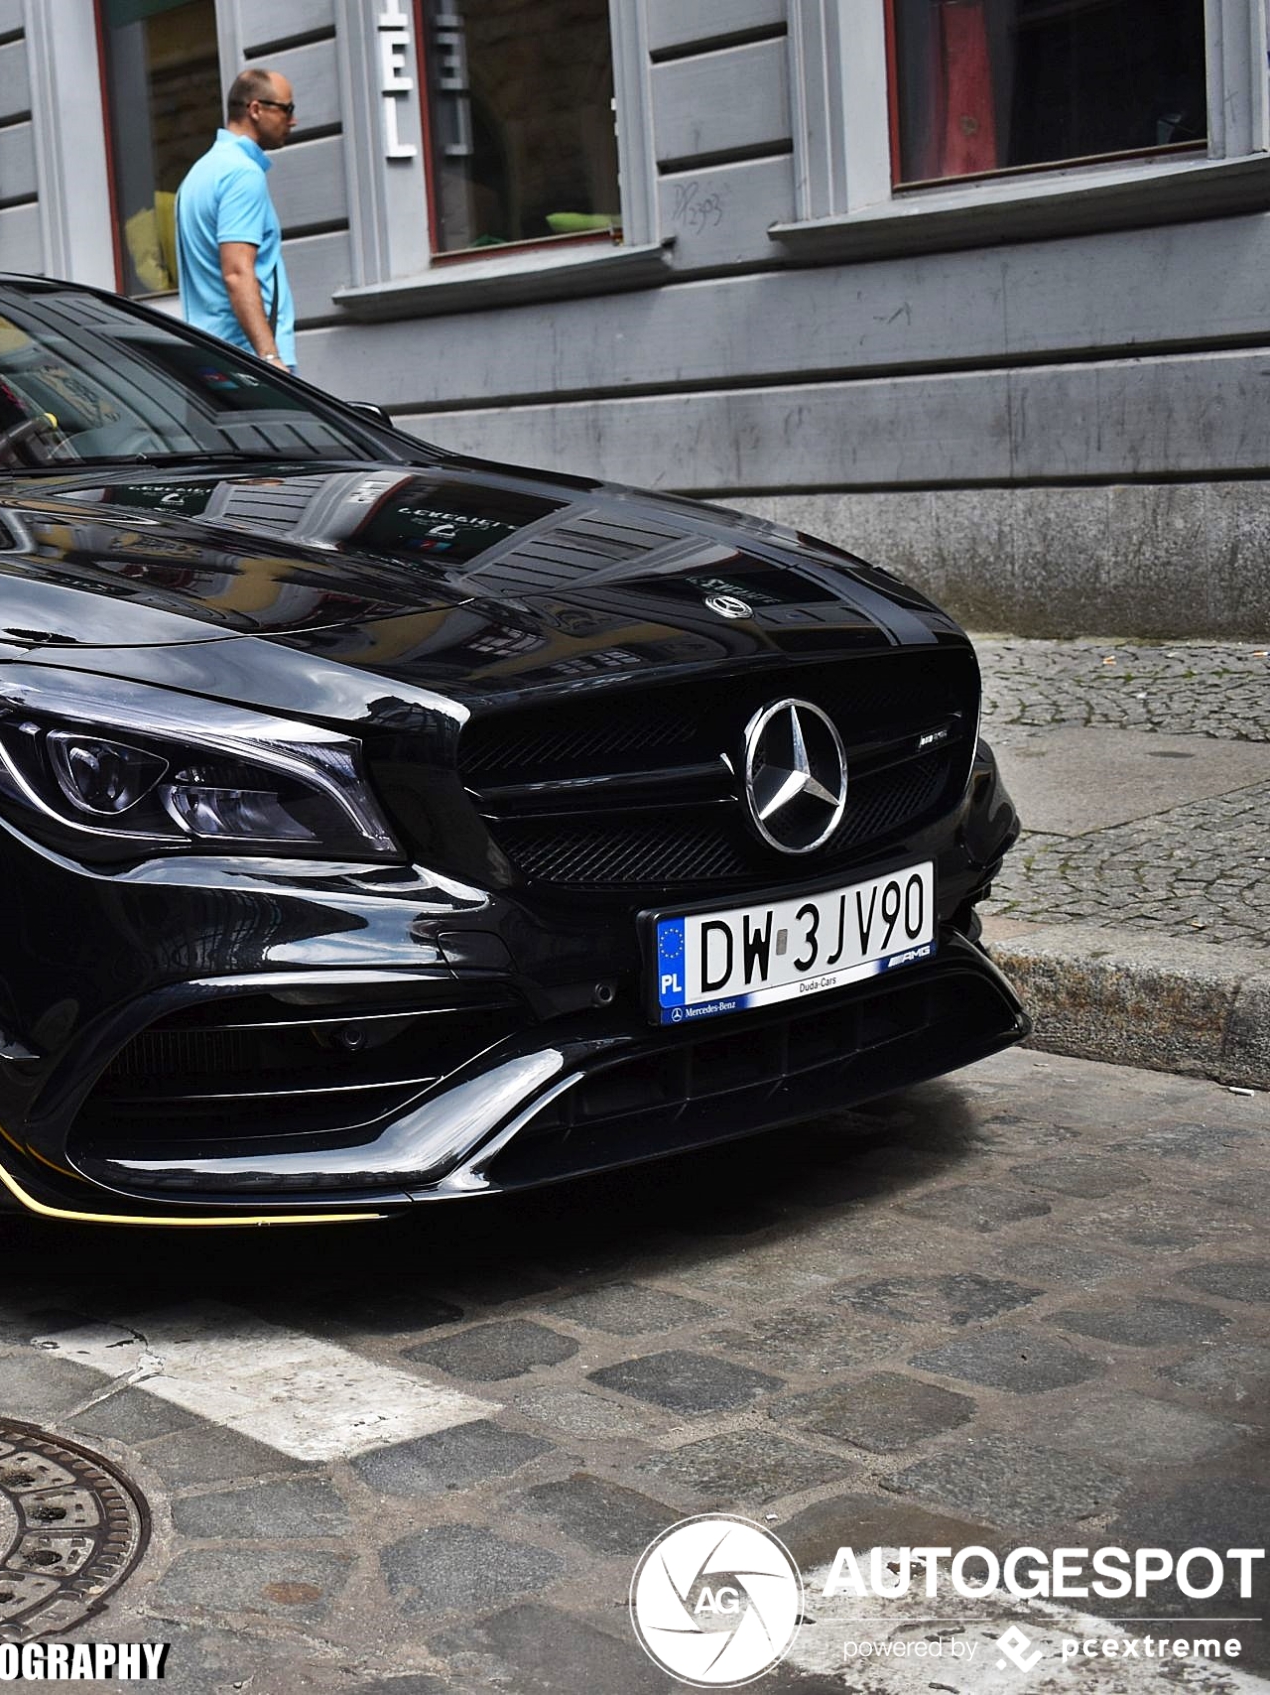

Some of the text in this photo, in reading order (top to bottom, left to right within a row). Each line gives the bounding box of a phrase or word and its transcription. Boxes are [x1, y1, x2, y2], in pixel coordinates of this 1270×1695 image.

[701, 873, 924, 993] DW 3JV90
[661, 973, 682, 994] PL
[800, 977, 836, 993] Duda-Cars
[686, 1002, 736, 1017] Mercedes-Benz
